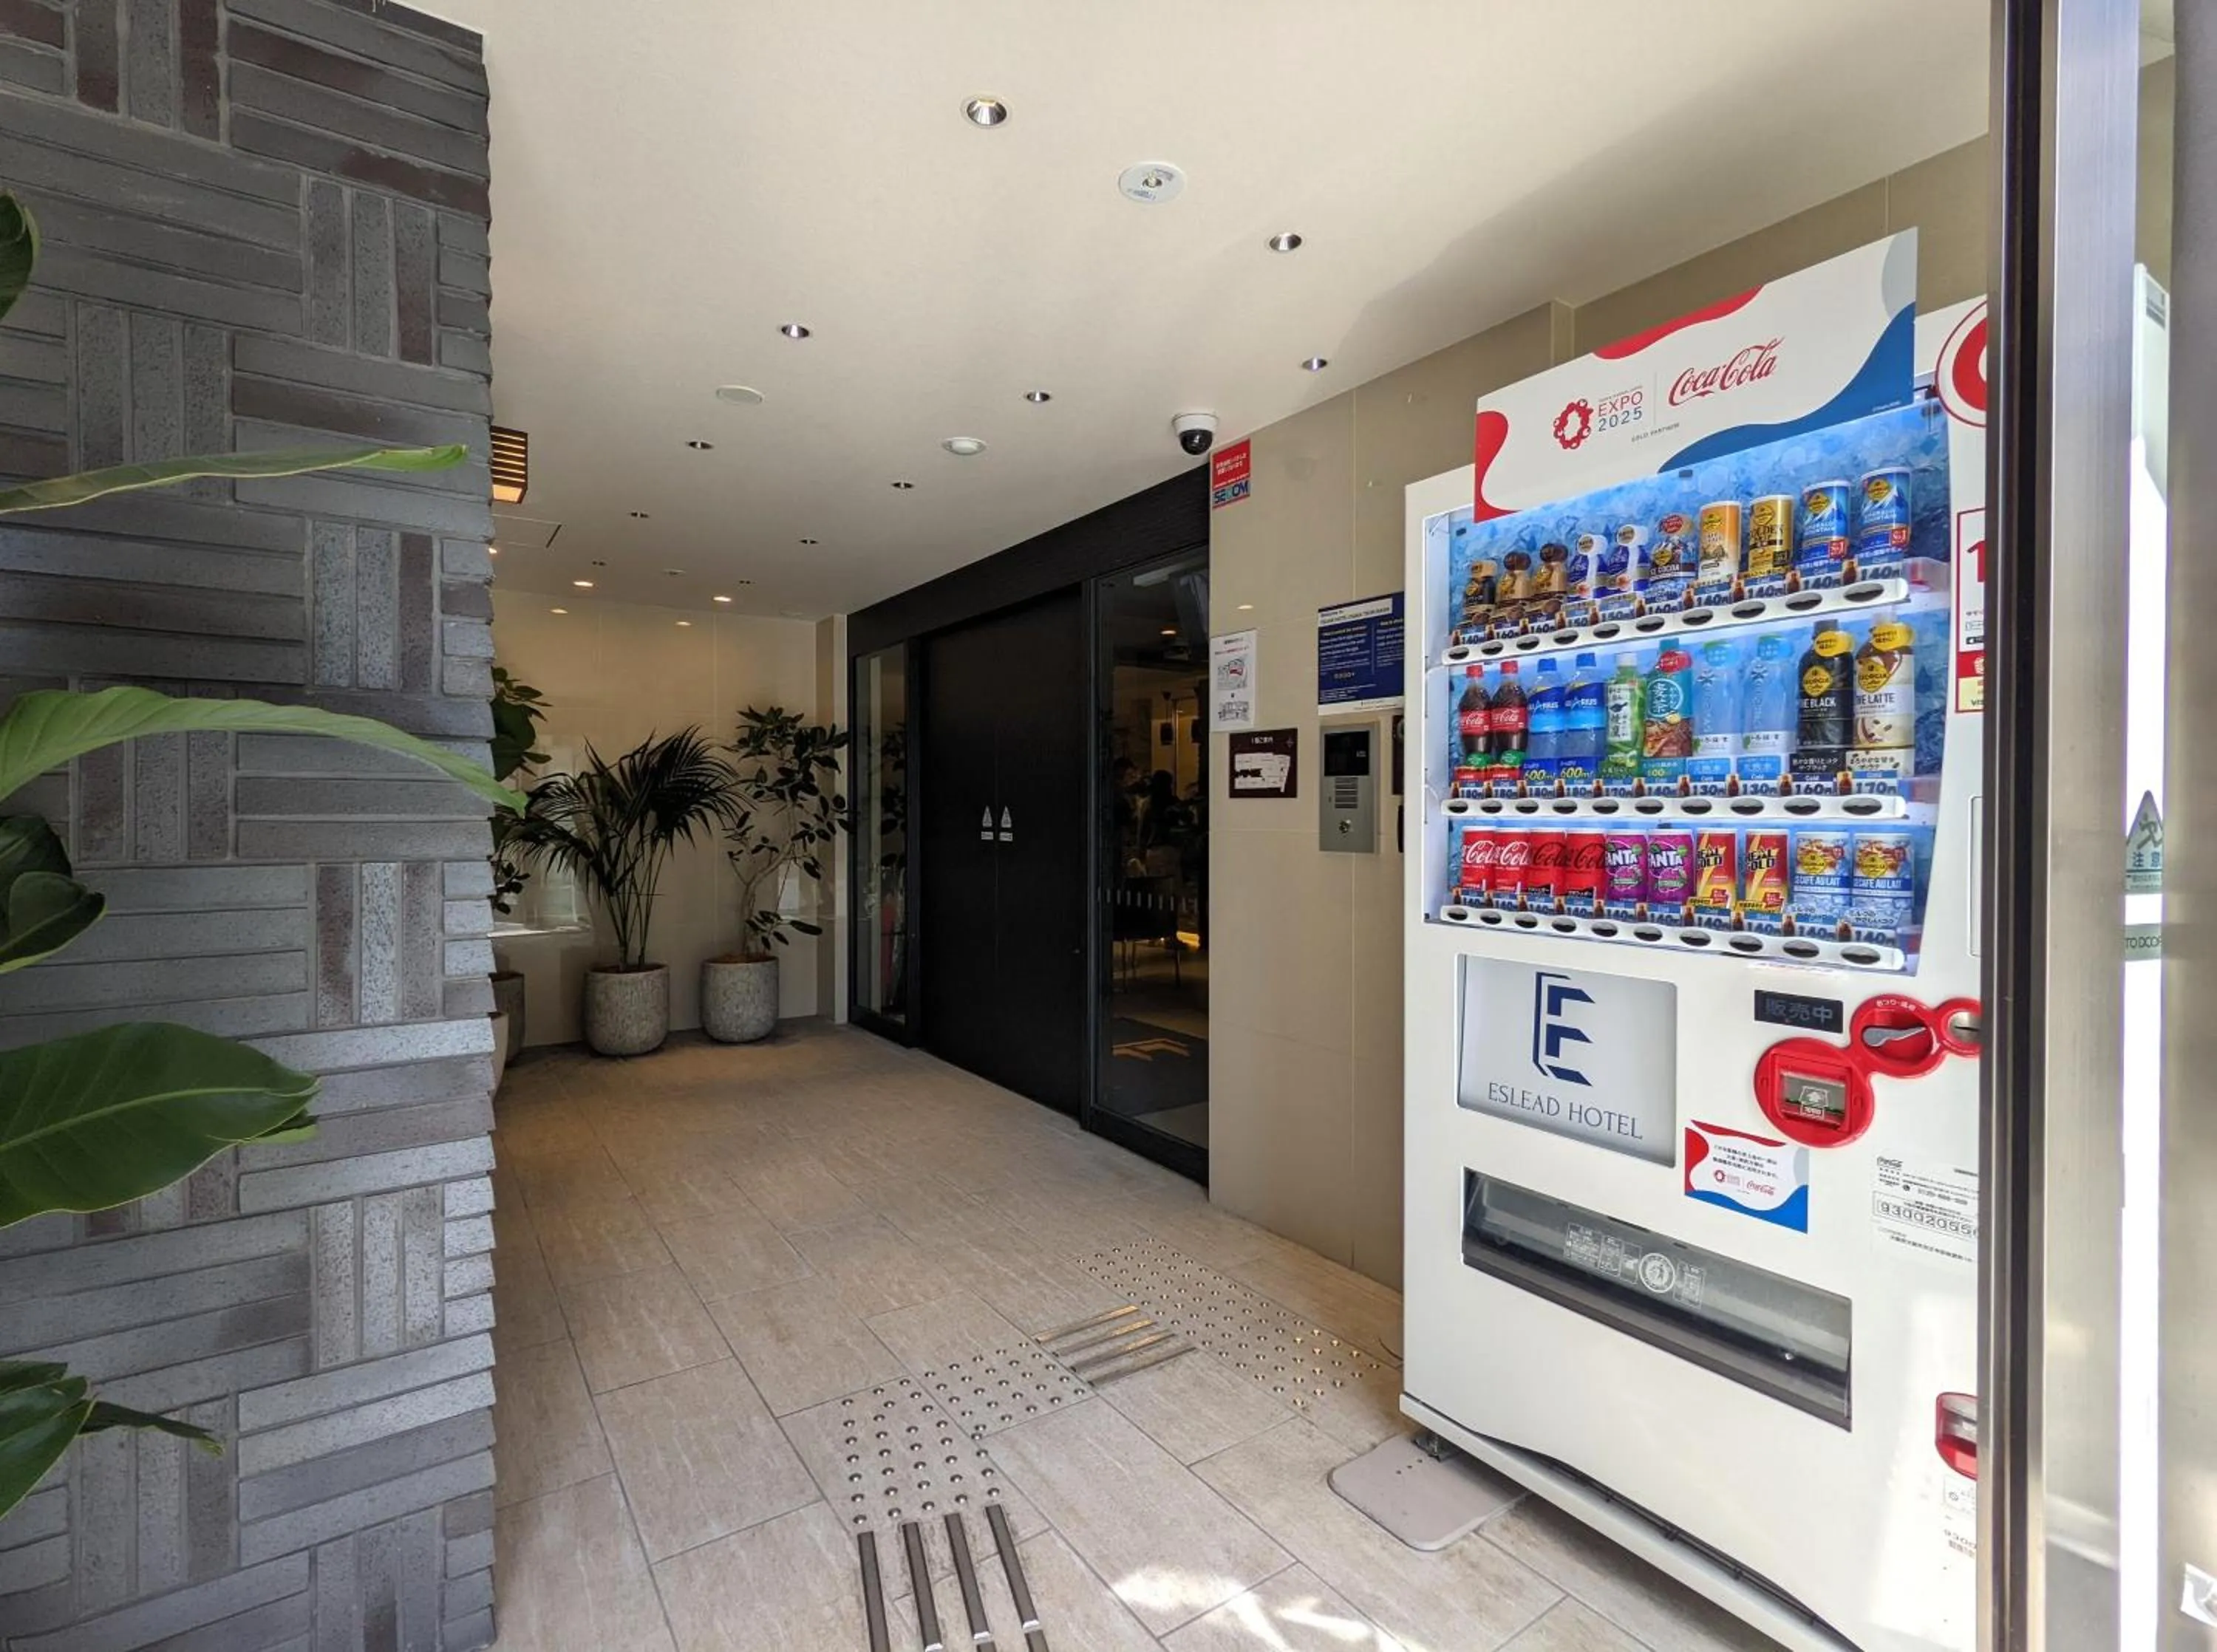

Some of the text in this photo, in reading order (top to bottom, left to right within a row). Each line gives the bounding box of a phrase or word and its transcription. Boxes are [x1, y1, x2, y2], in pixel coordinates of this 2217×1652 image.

[1669, 335, 1785, 406] Coca-Cola
[1598, 391, 1643, 417] EXPO
[1598, 406, 1643, 432] 2025
[1607, 850, 1638, 867] ANTA
[1649, 850, 1683, 867] ANTA
[1765, 997, 1833, 1030] 販売中
[1488, 1082, 1643, 1140] ESLEAD HOTEL
